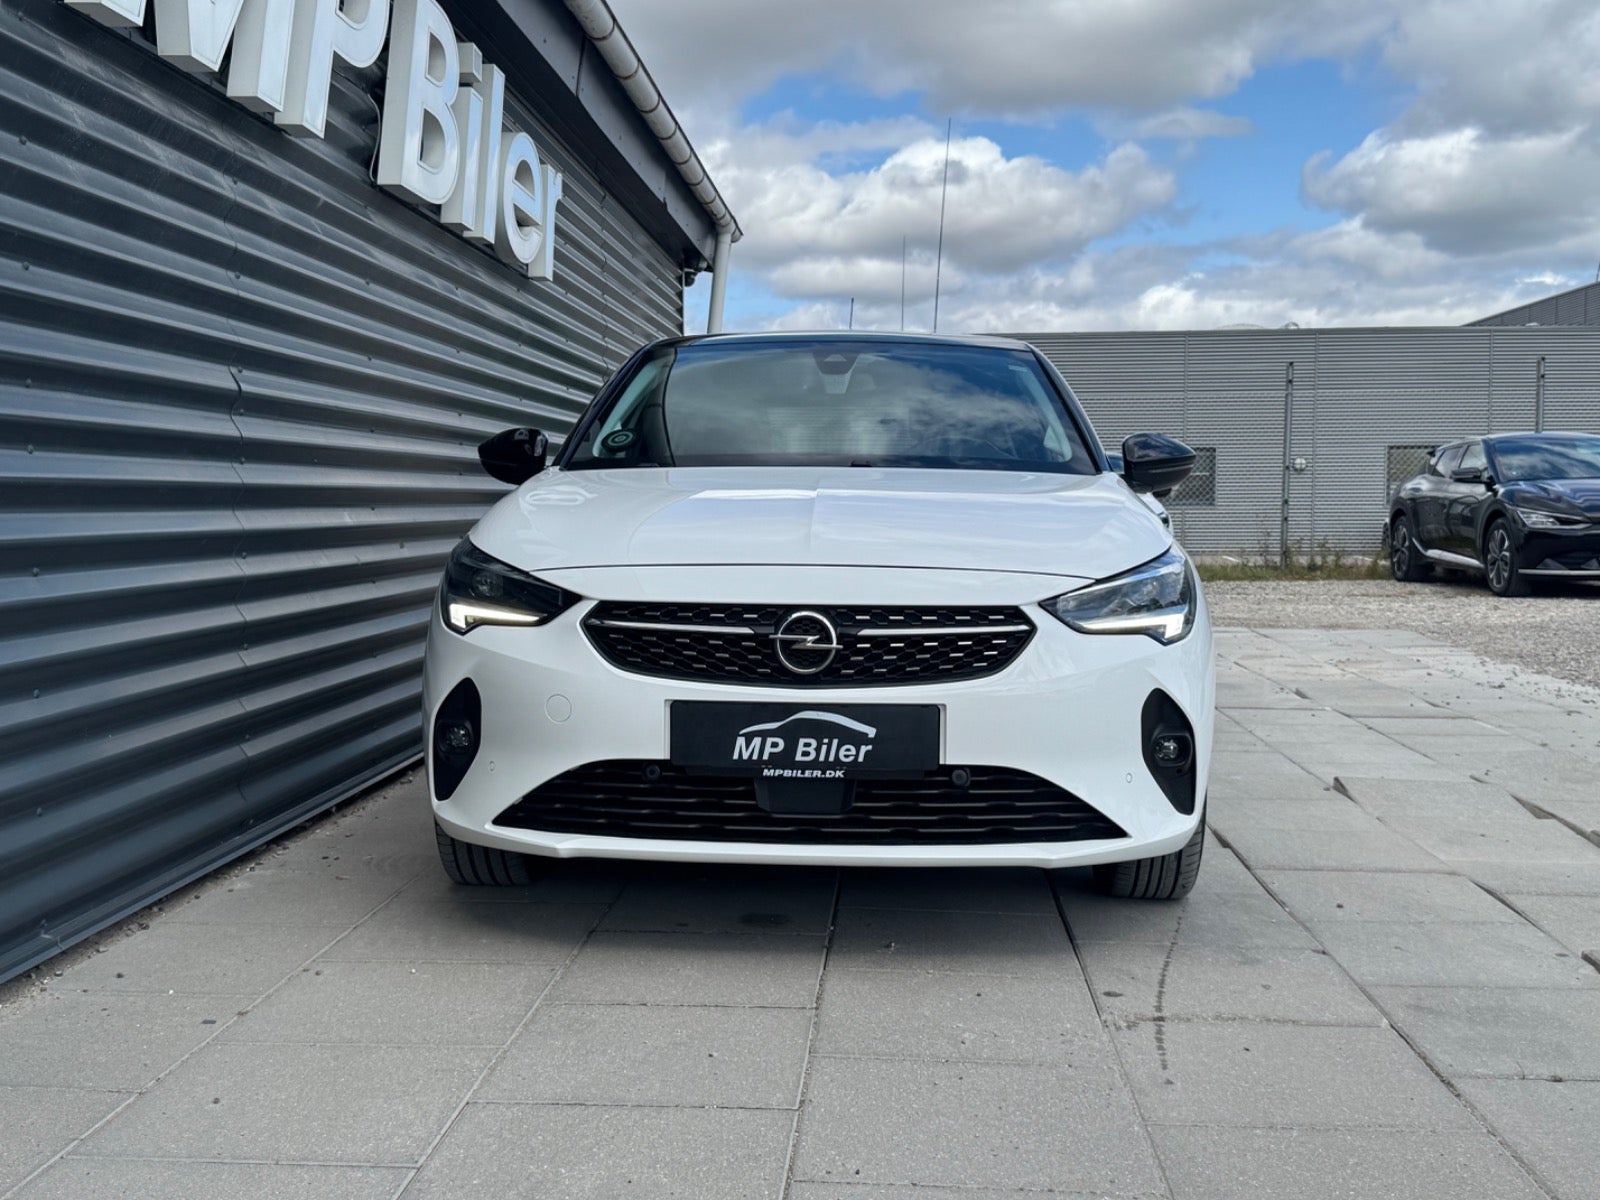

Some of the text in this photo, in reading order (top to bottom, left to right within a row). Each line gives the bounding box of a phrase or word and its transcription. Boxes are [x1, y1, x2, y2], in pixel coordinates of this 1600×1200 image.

[378, 0, 563, 281] Biler
[733, 736, 873, 763] MP Biler
[762, 768, 845, 778] MPBILER.DK
